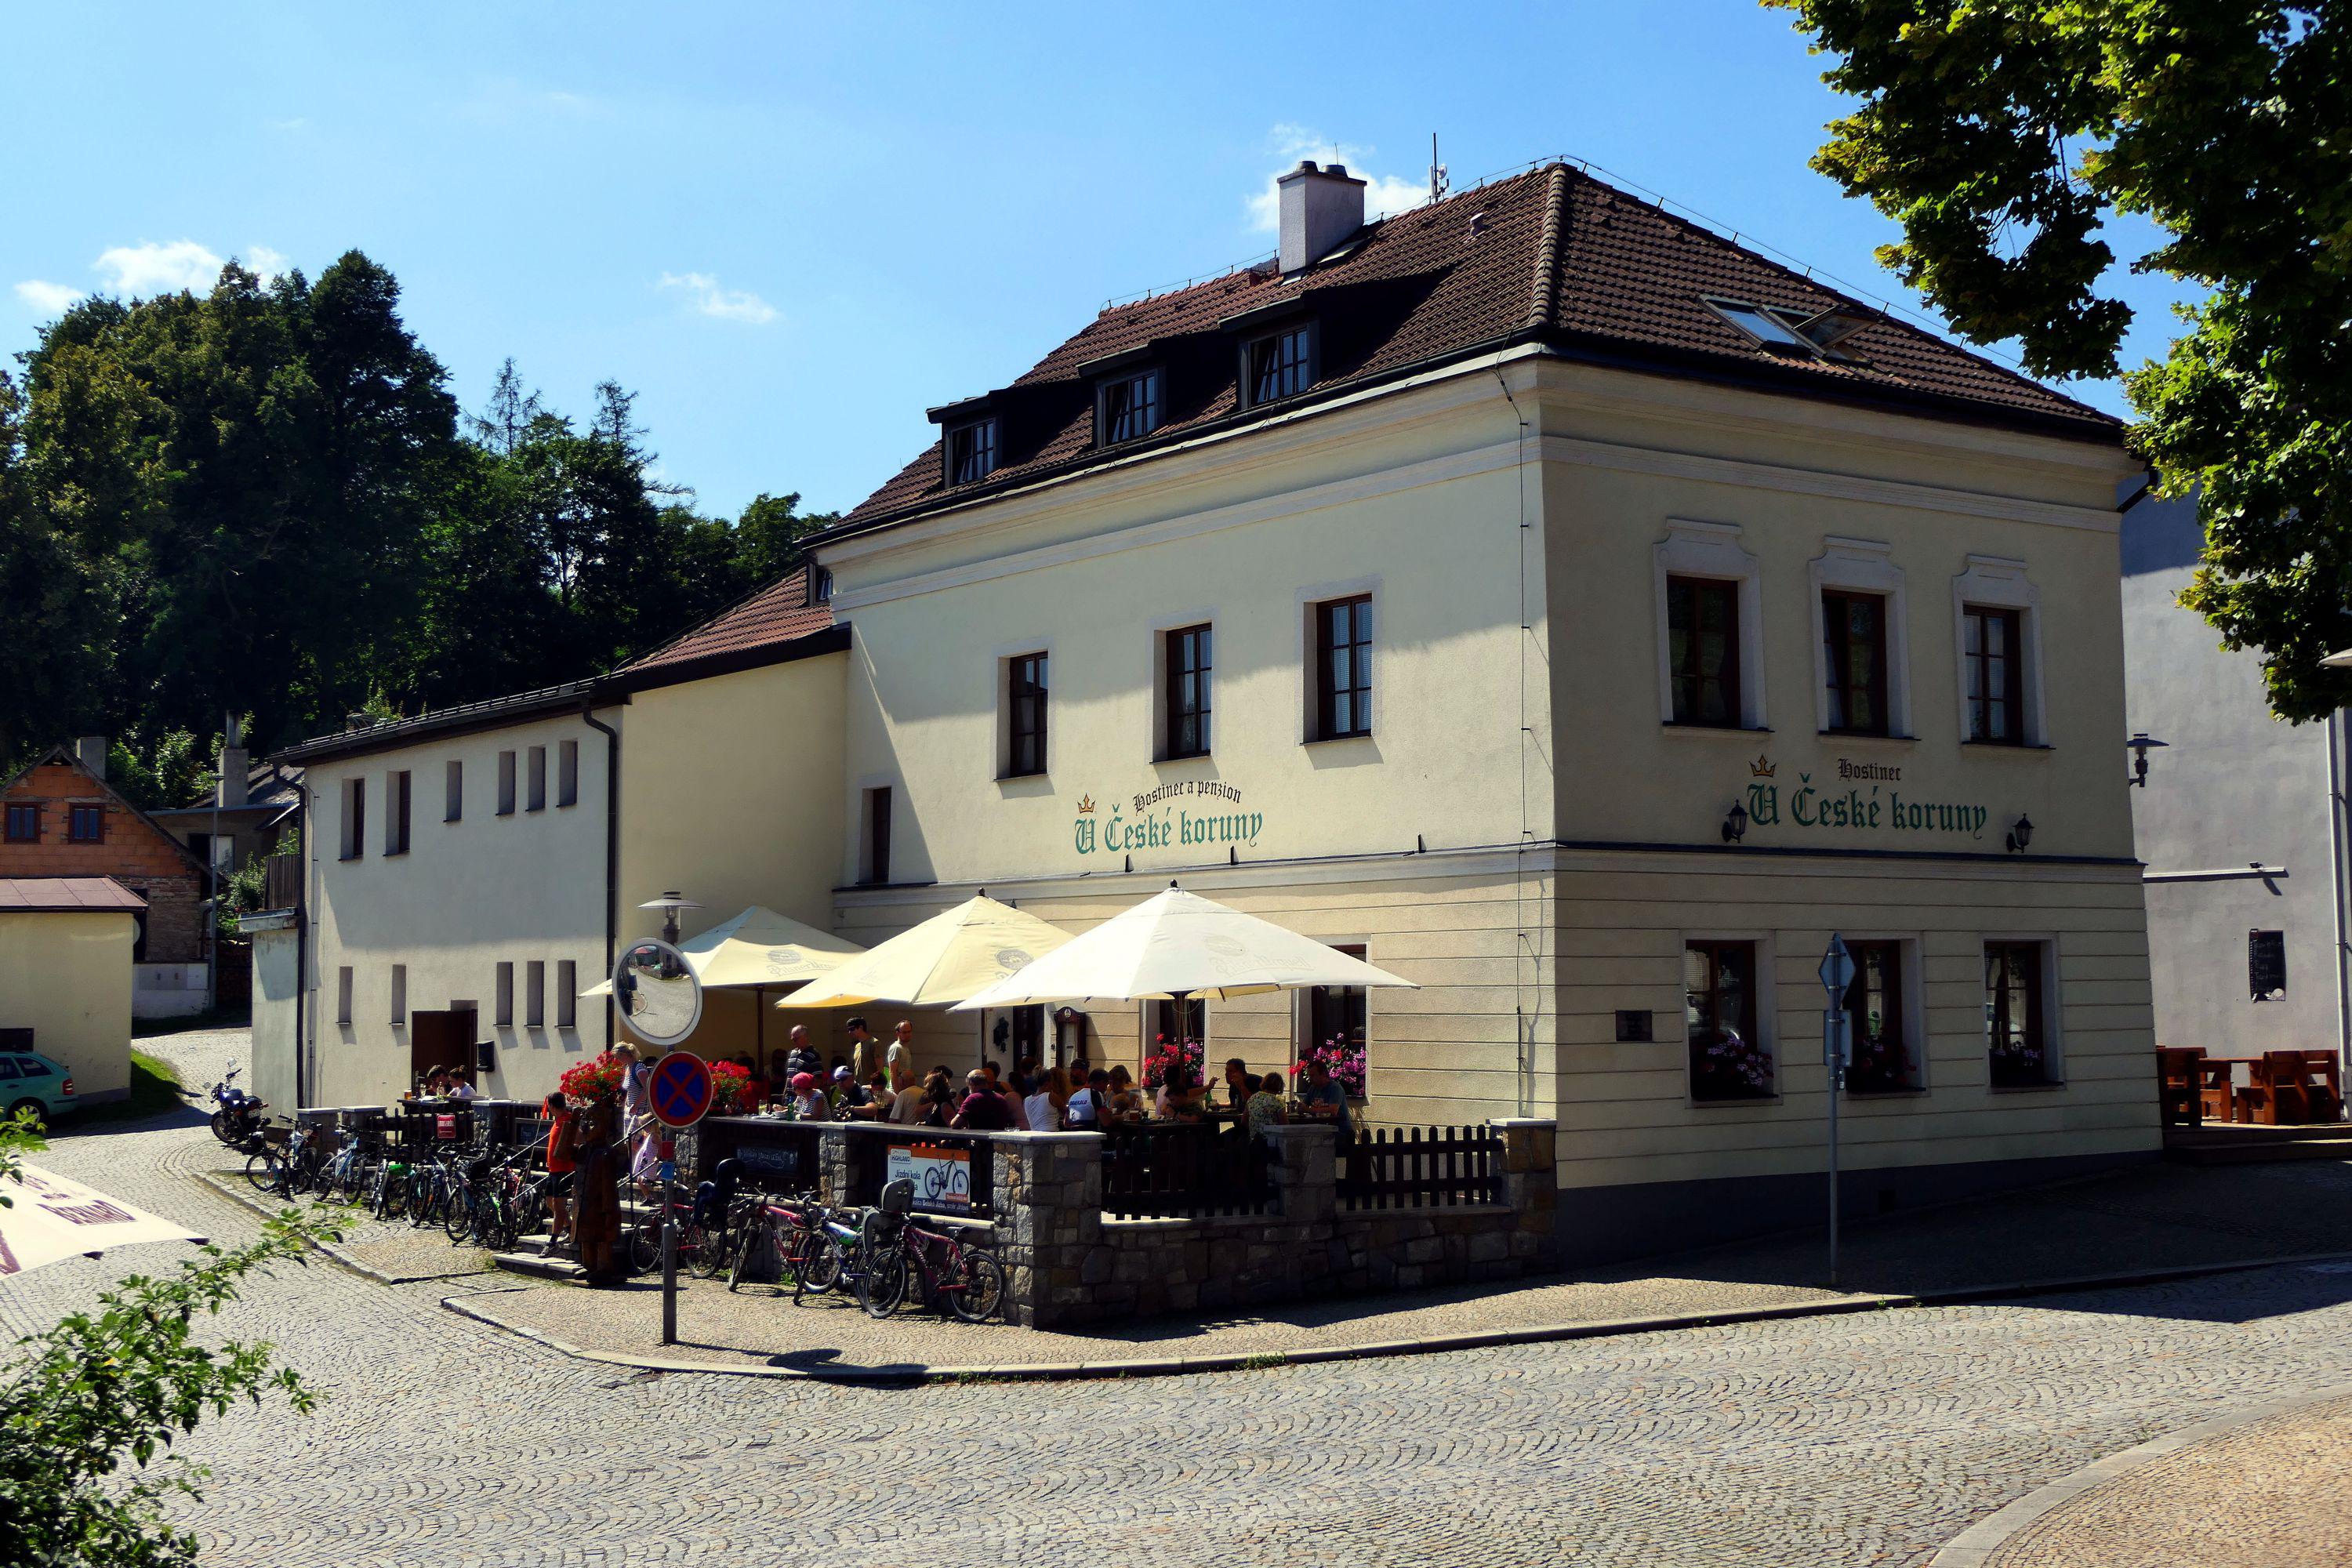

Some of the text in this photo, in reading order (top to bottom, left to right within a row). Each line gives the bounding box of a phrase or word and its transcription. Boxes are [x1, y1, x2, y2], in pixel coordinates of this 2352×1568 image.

[1838, 757, 1901, 782] Hostinec
[1133, 780, 1241, 816] Hostinec a penzion
[1747, 772, 1987, 840] U České koruny
[1074, 803, 1263, 855] U České koruny
